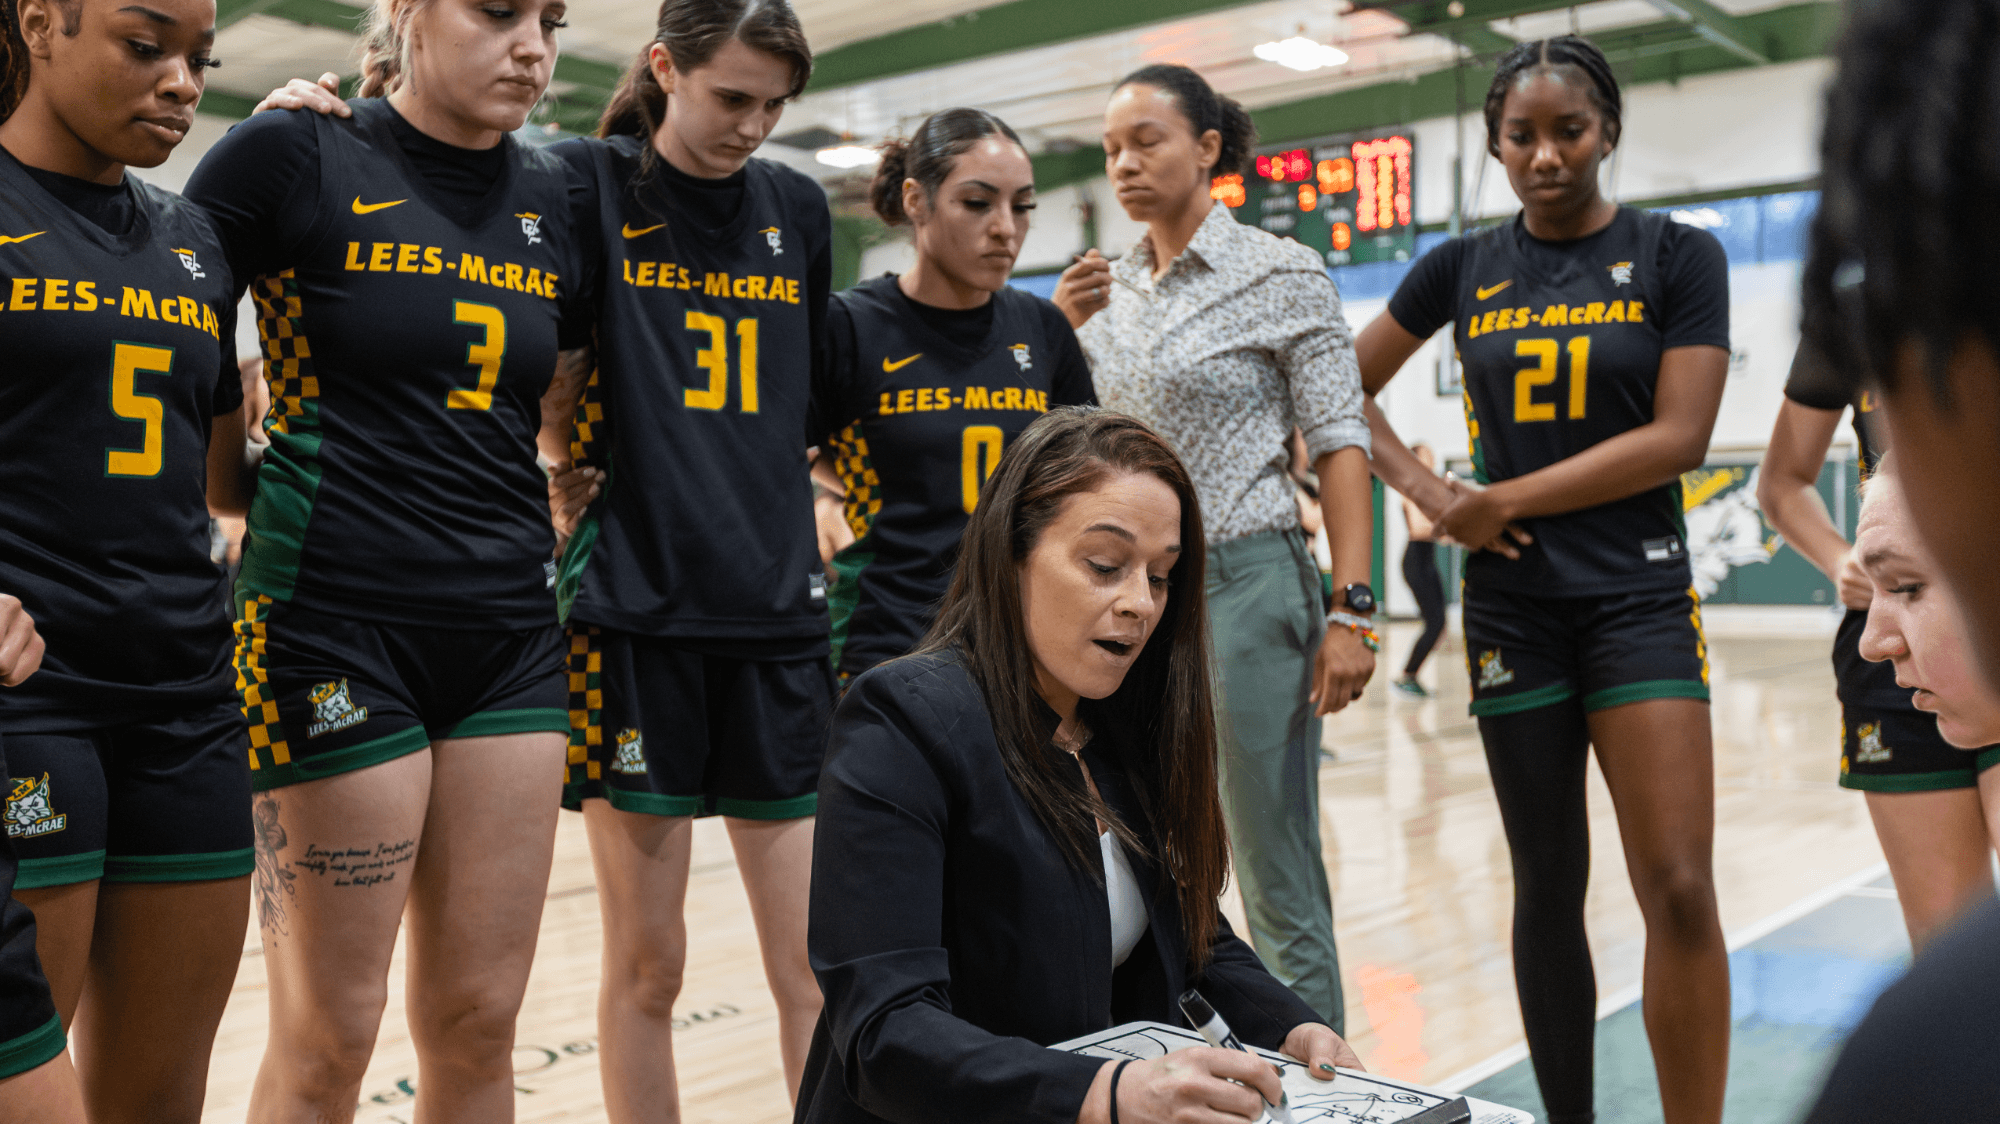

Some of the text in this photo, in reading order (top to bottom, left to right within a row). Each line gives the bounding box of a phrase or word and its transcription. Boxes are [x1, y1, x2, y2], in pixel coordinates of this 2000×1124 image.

[0, 277, 220, 341] EES-McRA
[444, 298, 508, 412] 3
[683, 308, 759, 414] 31
[1514, 334, 1591, 423] 21
[104, 340, 175, 479] 5
[961, 424, 1004, 515] 0
[5, 817, 63, 836] ES-McRAE
